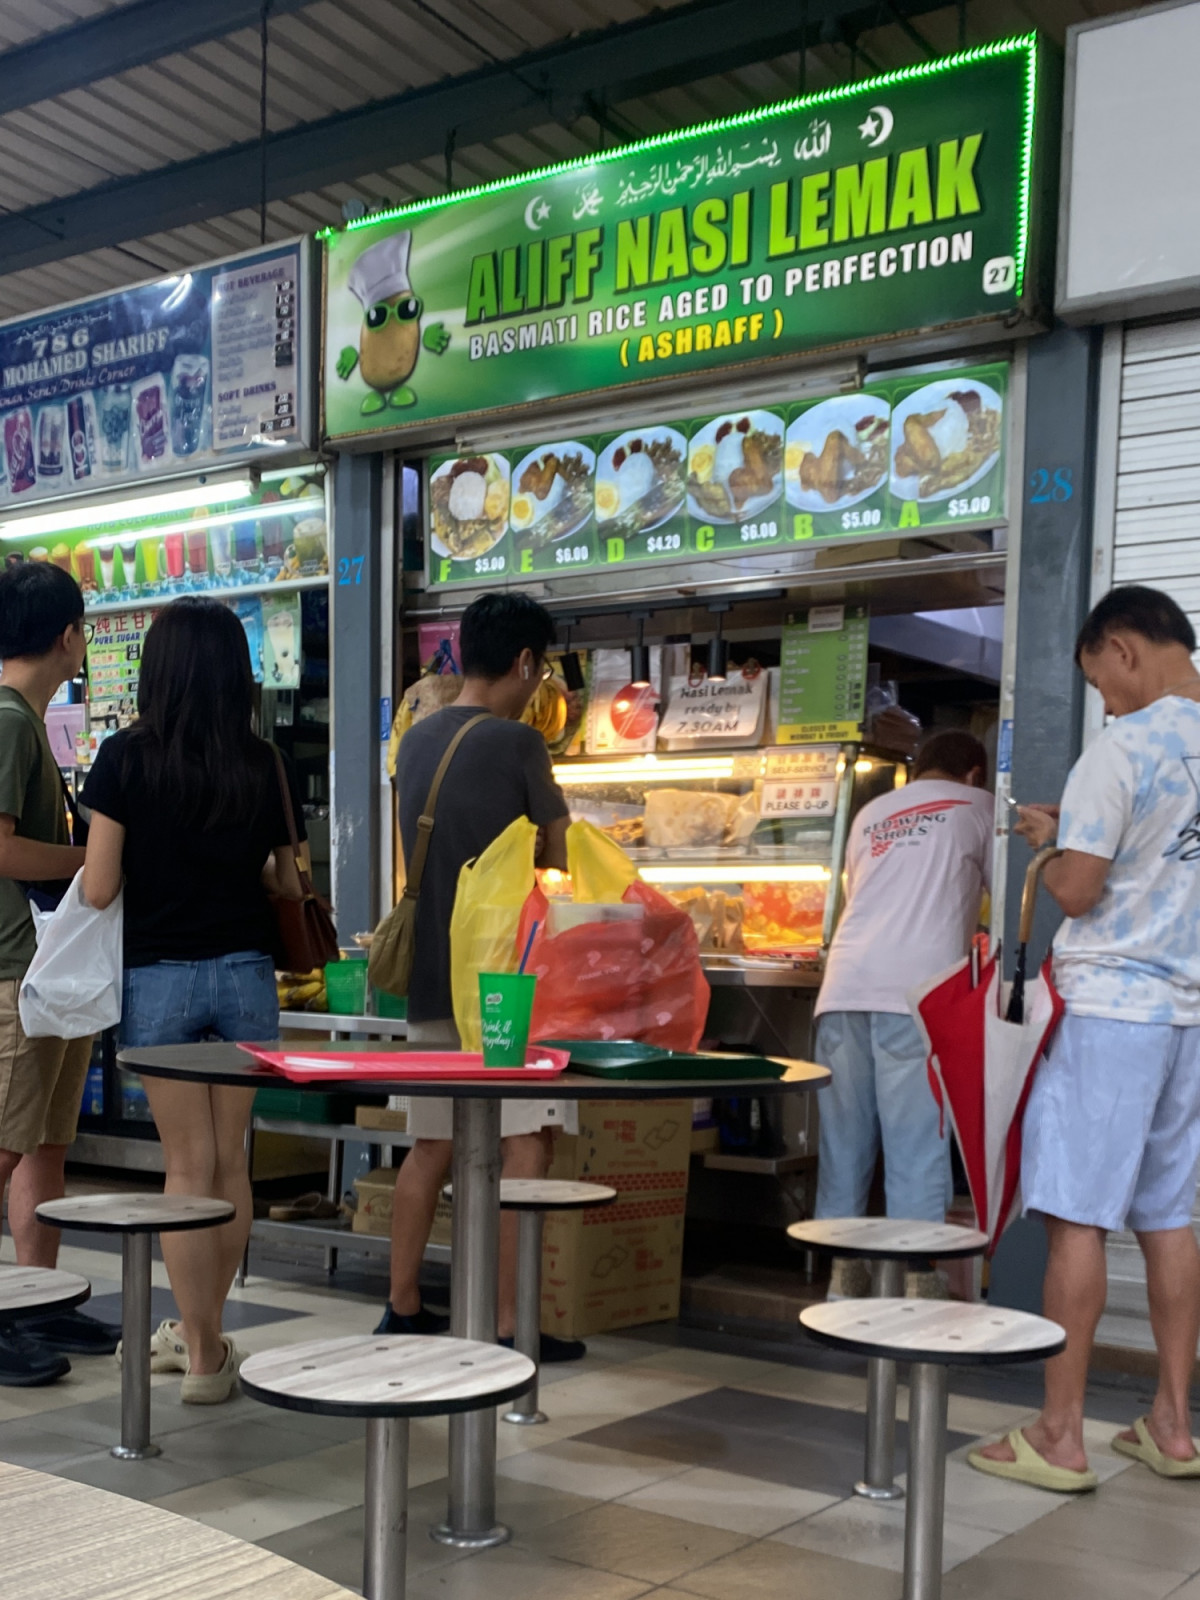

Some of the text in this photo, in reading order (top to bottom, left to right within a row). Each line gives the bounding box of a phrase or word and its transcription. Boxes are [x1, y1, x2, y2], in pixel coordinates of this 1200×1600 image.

[464, 132, 983, 327] ALIFF NASI LEMAK
[238, 267, 285, 289] BEVERAGE
[988, 266, 1010, 285] 27
[469, 230, 973, 361] BASMATI RICE AGED TO PERFECTION
[638, 312, 764, 363] ASHRAFF
[3, 350, 88, 388] MOHAMED
[92, 326, 170, 367] SHARIFF
[98, 365, 137, 384] Corner
[218, 381, 276, 403] SOFT DRINKS
[1030, 467, 1073, 504] 28
[793, 510, 881, 539] B $5.00
[898, 496, 991, 528] A $5.00
[607, 534, 681, 563] D $4.20
[696, 522, 778, 551] C $6.00
[338, 555, 365, 586] 27
[439, 556, 505, 582] F $5.00
[520, 546, 589, 573] E $6.00
[95, 636, 114, 645] PURE
[117, 631, 141, 643] SUGAR
[681, 685, 753, 698] Nasi Lemak
[676, 720, 739, 733] 7.30AM
[766, 800, 829, 811] PLEASE Q-UP
[863, 812, 946, 836] RED WING
[875, 826, 928, 841] SHOES
